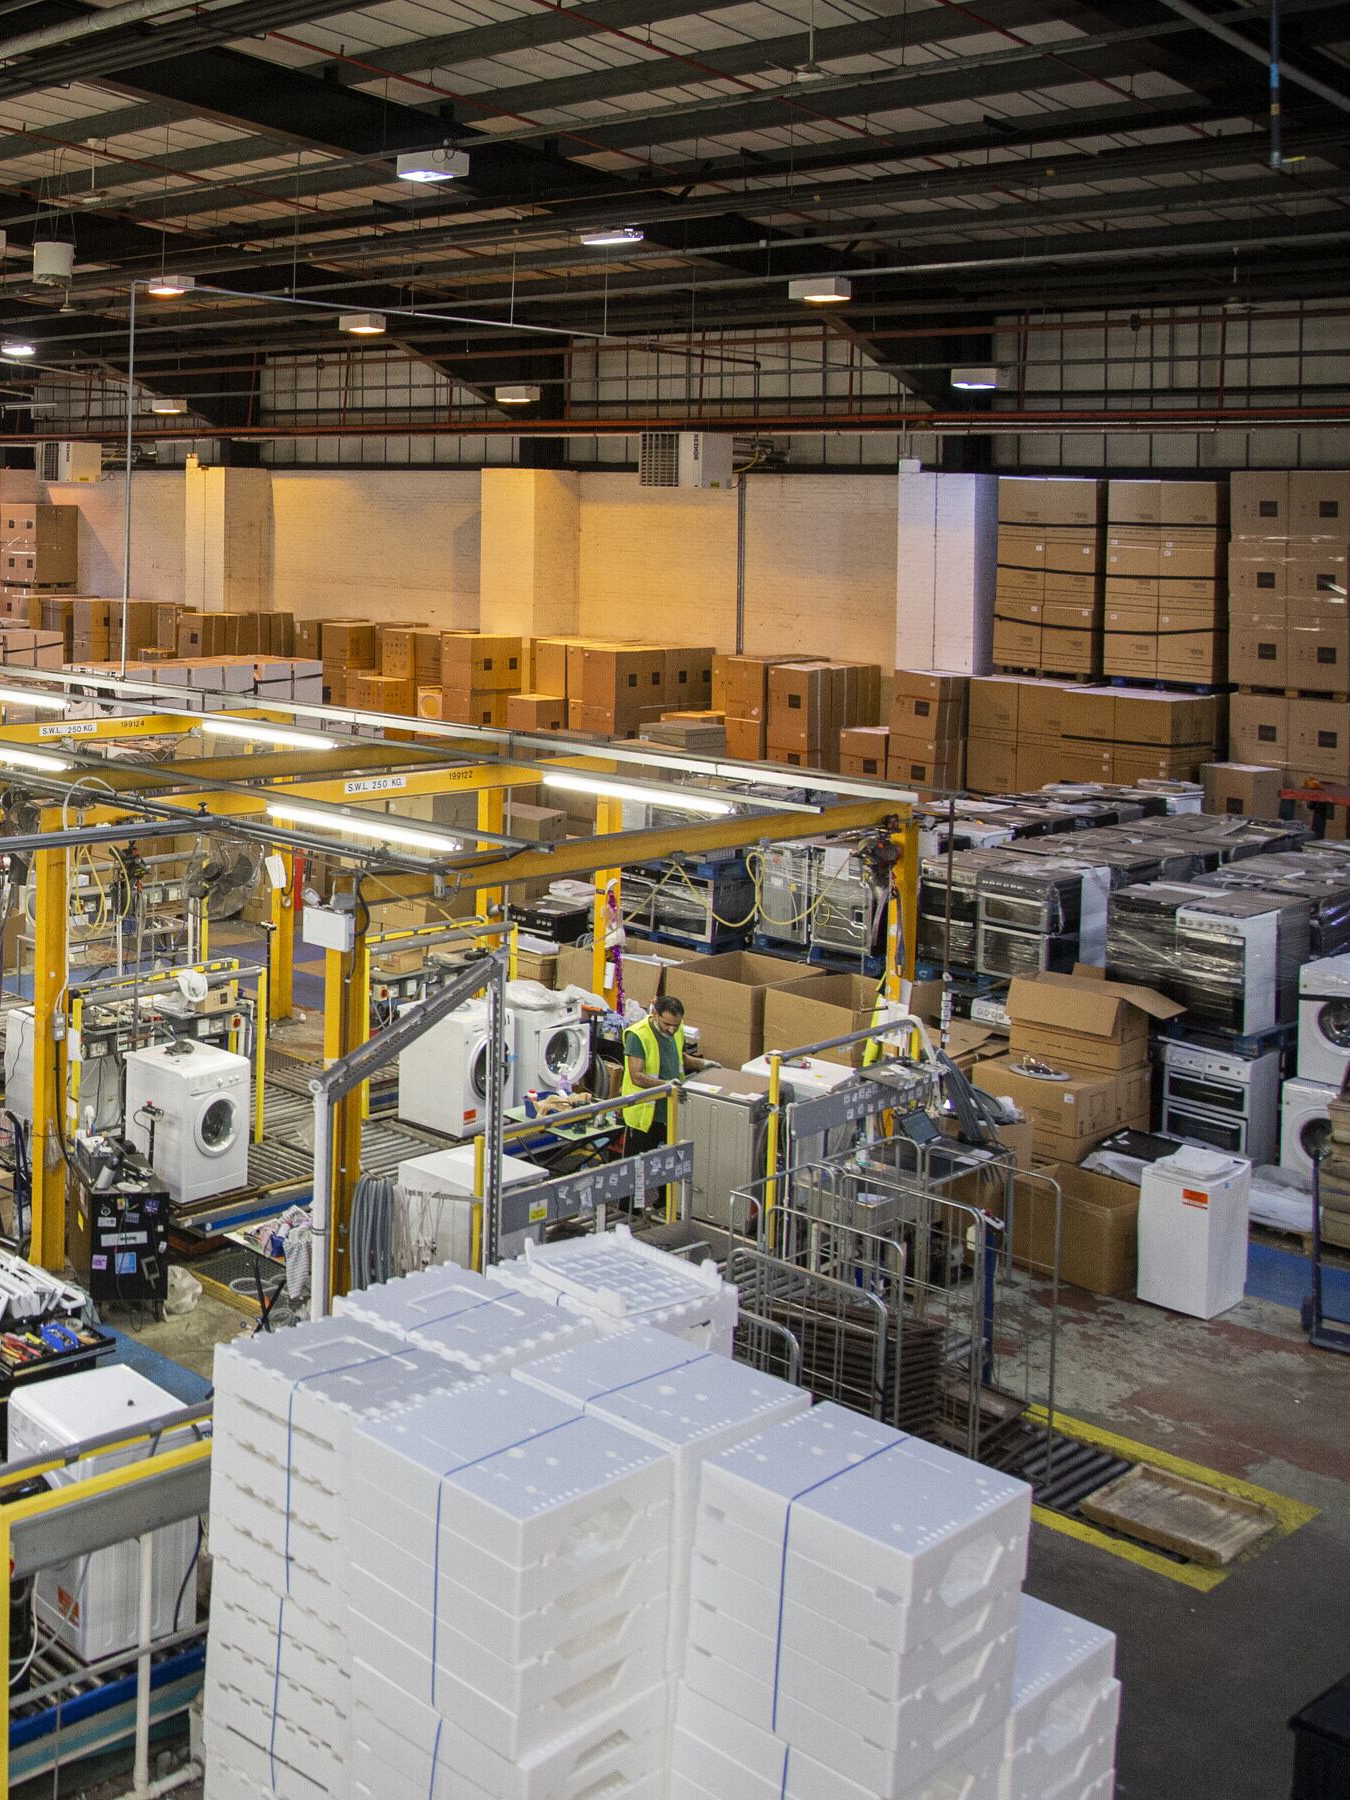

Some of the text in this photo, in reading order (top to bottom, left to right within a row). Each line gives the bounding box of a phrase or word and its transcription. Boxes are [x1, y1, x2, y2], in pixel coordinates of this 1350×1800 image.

[121, 720, 145, 728] 199124
[67, 725, 82, 733] 250
[449, 770, 473, 780] 199122
[372, 780, 388, 789] 250
